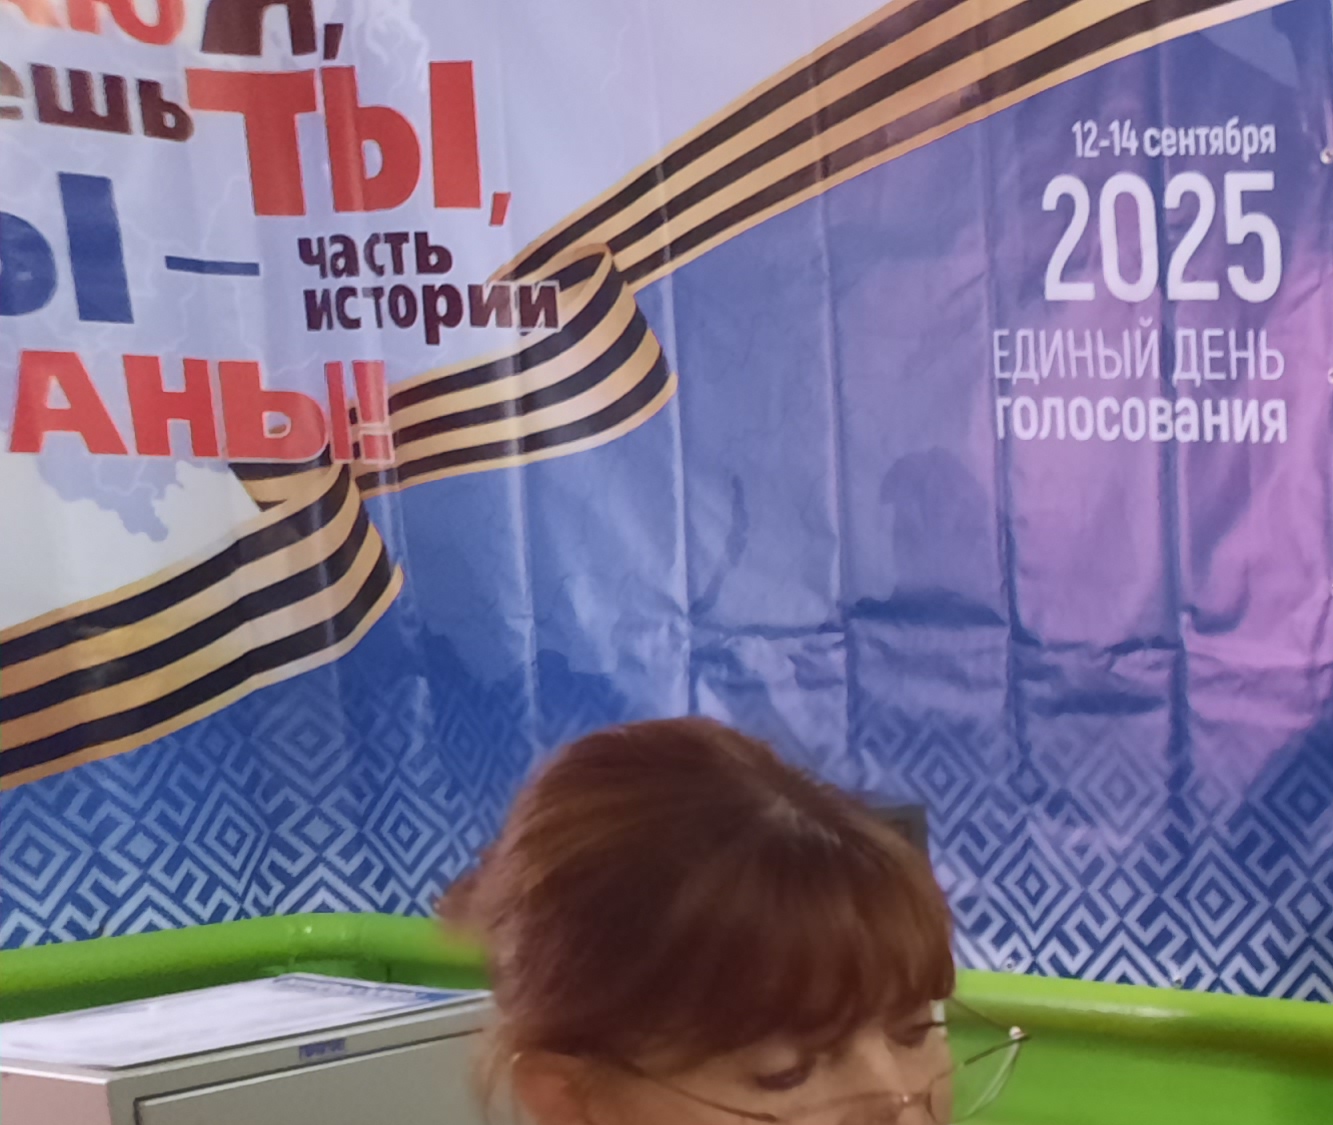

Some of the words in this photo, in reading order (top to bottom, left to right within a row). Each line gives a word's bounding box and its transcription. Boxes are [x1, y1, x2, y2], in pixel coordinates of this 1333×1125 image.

[185, 60, 512, 226] ТЫ,
[1072, 119, 1138, 158] 12-14
[1143, 116, 1277, 162] сентября
[297, 231, 454, 279] часть
[1041, 171, 1283, 303] 2025
[303, 280, 561, 346] истории
[993, 316, 1160, 385] ЕДИНЫЙ
[1172, 328, 1286, 387] ДЕНЬ
[996, 395, 1288, 444] голосования
